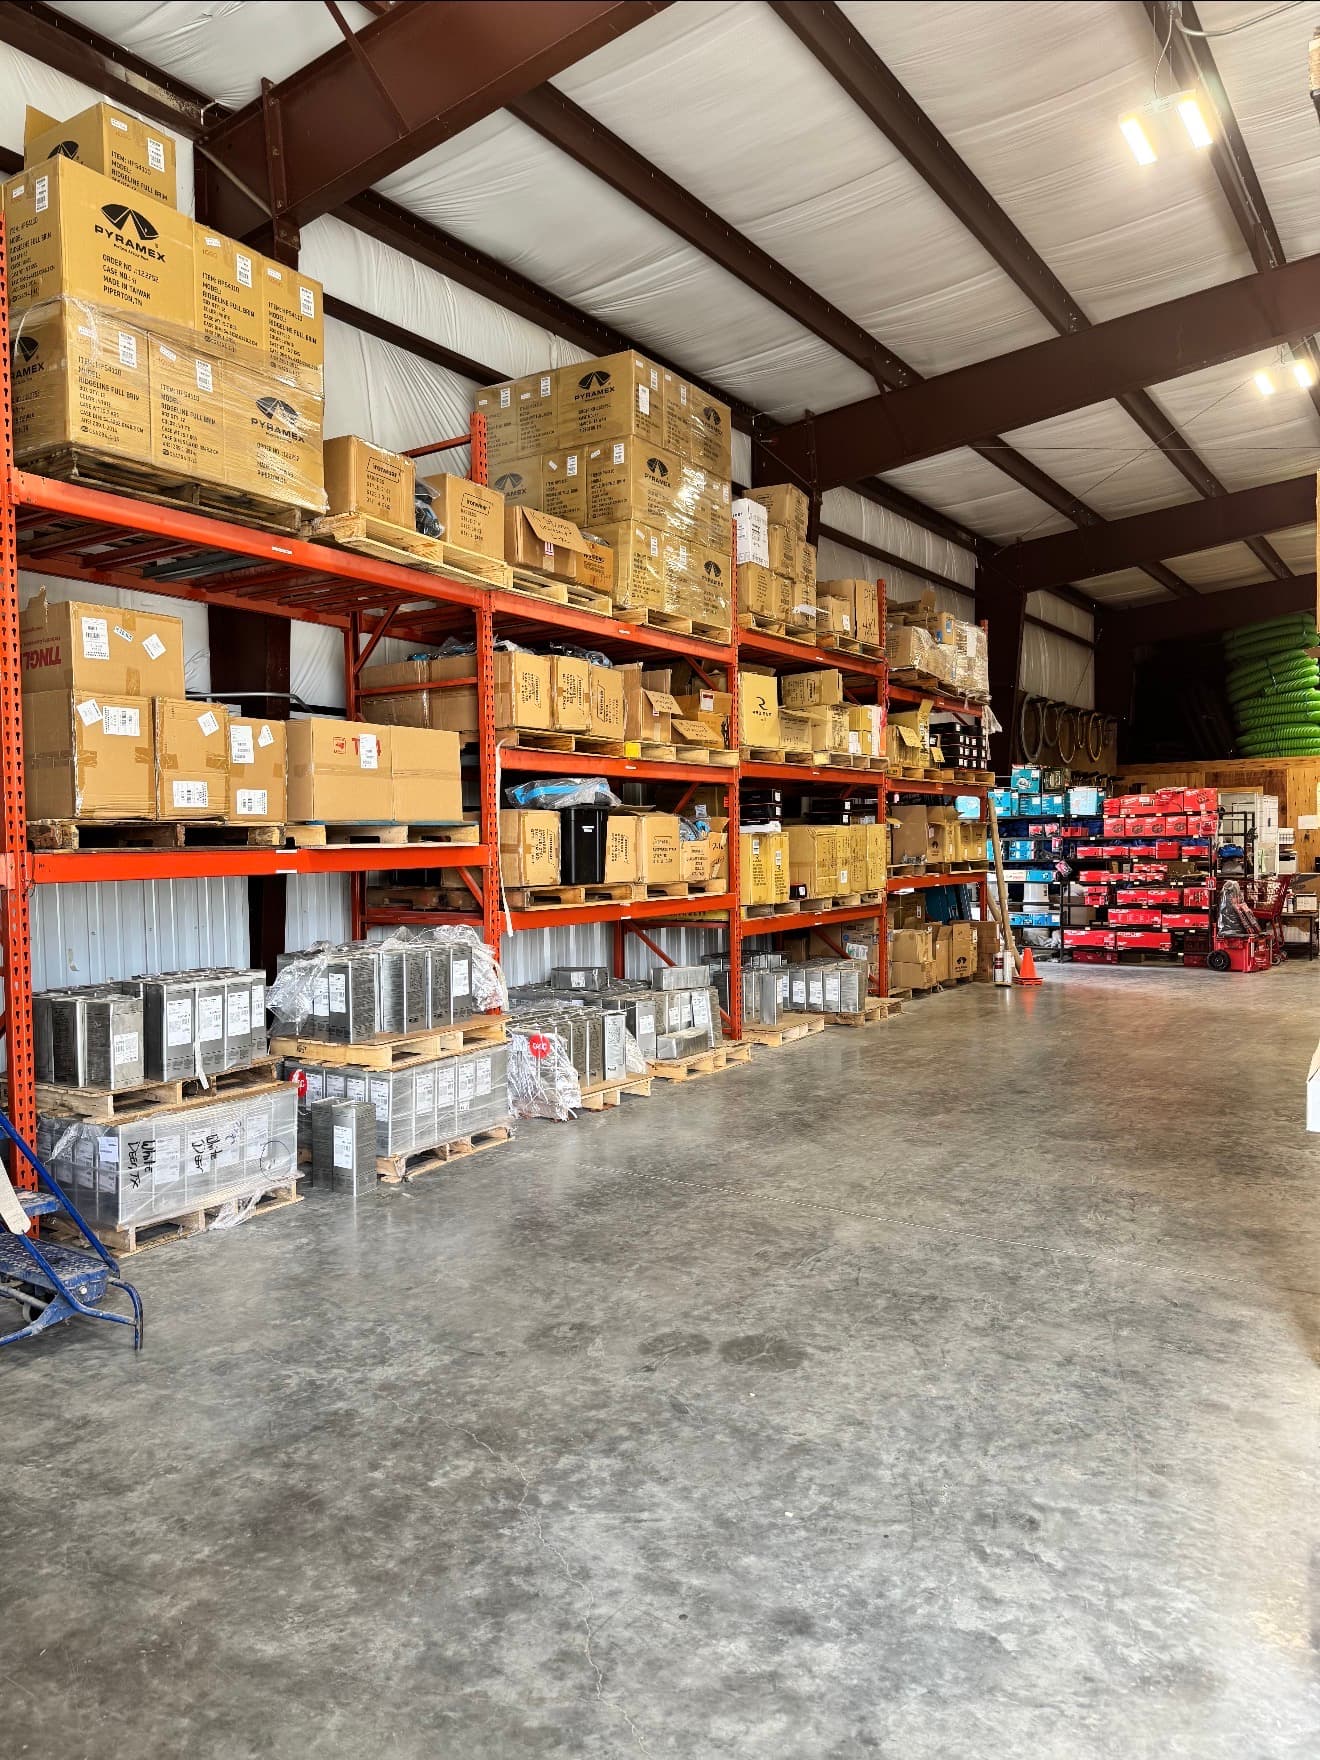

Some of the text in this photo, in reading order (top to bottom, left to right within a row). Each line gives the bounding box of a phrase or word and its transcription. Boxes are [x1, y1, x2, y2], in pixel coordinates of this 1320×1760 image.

[111, 168, 140, 187] RIDGELINE
[140, 182, 153, 194] FULL
[94, 224, 167, 263] PYRAMEX
[102, 253, 123, 267] ORDER
[102, 264, 118, 277] CASE
[103, 275, 120, 287] MADE
[121, 283, 128, 291] IN
[130, 285, 151, 300] TAIWAN
[78, 376, 110, 392] RIDGELINE
[574, 386, 615, 401] PYRAMEX
[251, 417, 306, 443] PYRAMEX
